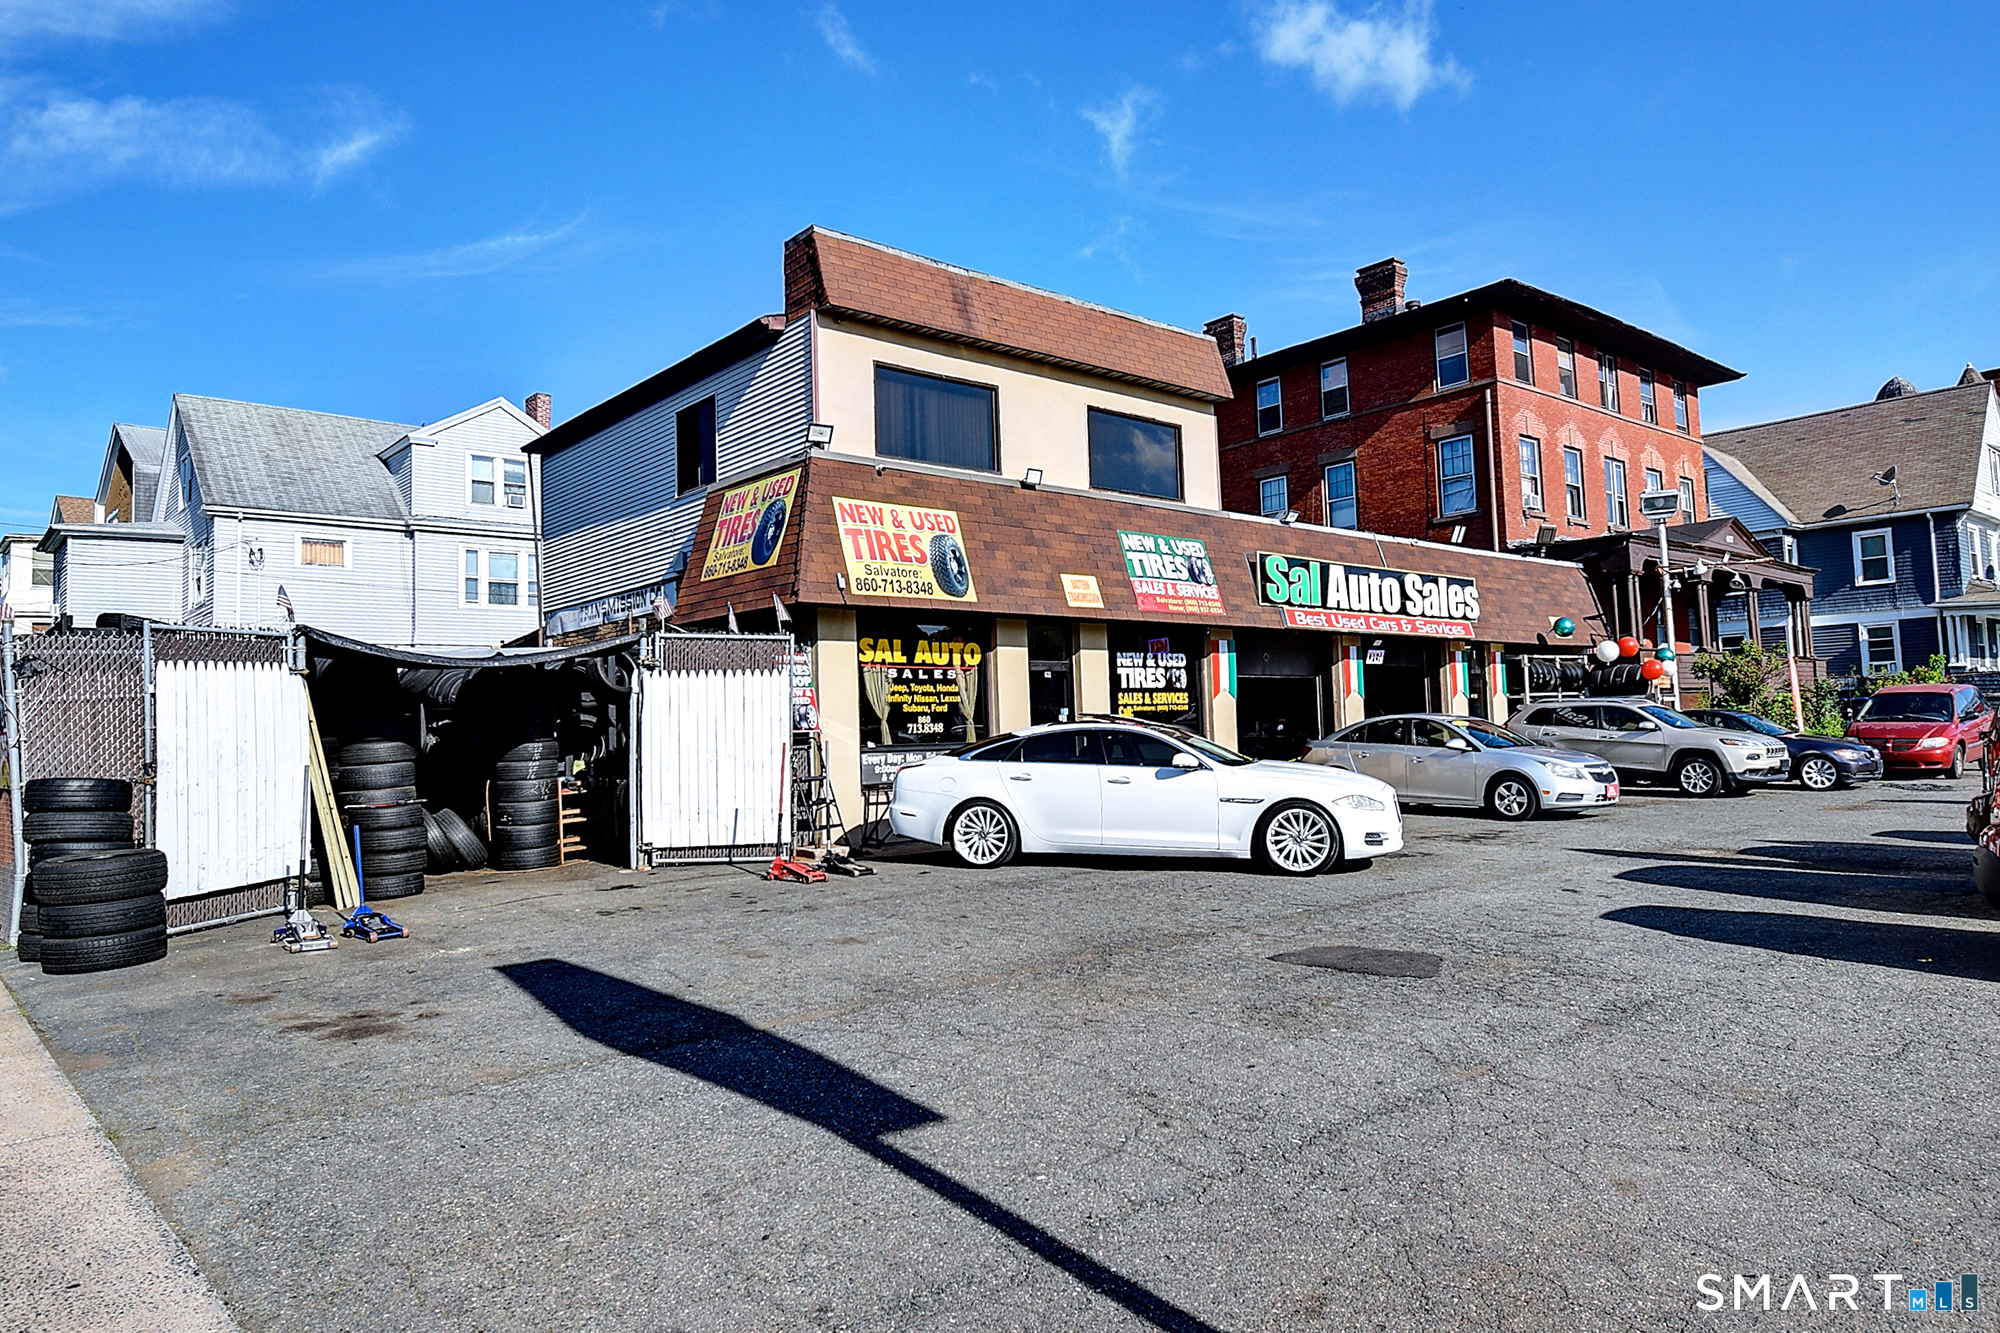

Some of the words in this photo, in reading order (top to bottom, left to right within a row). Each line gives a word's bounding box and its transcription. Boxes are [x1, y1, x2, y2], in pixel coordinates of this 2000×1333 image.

[721, 489, 750, 516] NEW
[750, 486, 760, 508] &
[761, 475, 795, 503] USED
[838, 502, 884, 527] NEW
[890, 509, 906, 530] &
[908, 511, 957, 535] USED
[714, 508, 761, 550] TIRES
[843, 528, 928, 566] TIRES
[1120, 533, 1155, 551] NEW
[1158, 537, 1172, 554] &
[1170, 539, 1206, 558] USED
[864, 564, 922, 579] Salvatore:
[1126, 551, 1190, 580] TIRES
[855, 577, 934, 596] 860-713-8348
[1134, 581, 1166, 595] SALES
[1166, 583, 1176, 596] &
[1176, 584, 1219, 600] SERVICES
[1264, 554, 1322, 607] Sal
[1326, 564, 1402, 614] Auto
[1403, 572, 1482, 620] Sales
[1294, 611, 1329, 627] Best
[1330, 614, 1367, 630] Used
[1369, 616, 1399, 632] Cars
[1402, 618, 1413, 633] &
[1415, 620, 1466, 637] Services
[858, 638, 907, 664] SAL
[913, 640, 982, 666] AUTO
[1116, 652, 1144, 667] NEW
[1146, 652, 1157, 667] &
[1157, 652, 1187, 668] USED
[888, 668, 957, 680] SALES
[1116, 667, 1166, 689] TIRES
[890, 683, 909, 693] Jeep,
[910, 683, 936, 693] Toyota,
[936, 683, 959, 692] Honda
[913, 694, 939, 704] Nissan,
[940, 694, 961, 703] Lexus
[1118, 692, 1143, 704] SALES
[1144, 692, 1152, 704] &
[1152, 692, 1189, 704] SERVICES
[903, 704, 930, 713] Subaru,
[931, 704, 948, 712] Ford
[907, 723, 944, 734] 713.8348
[918, 715, 931, 724] 860
[861, 754, 886, 766] Every
[887, 753, 905, 765] Day:
